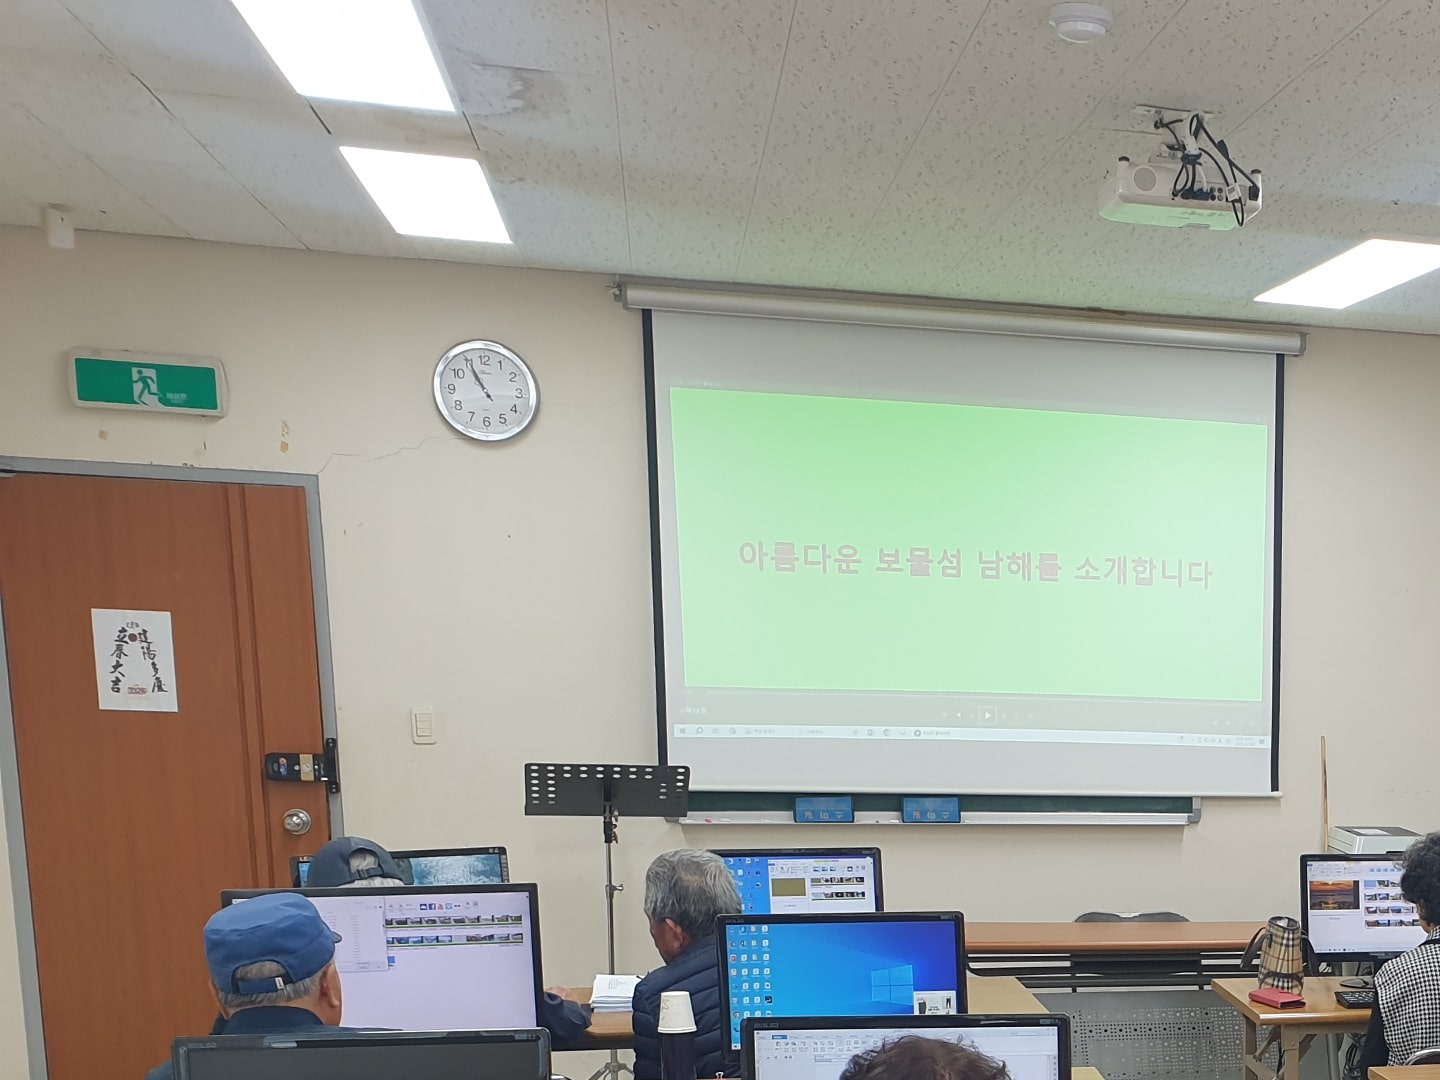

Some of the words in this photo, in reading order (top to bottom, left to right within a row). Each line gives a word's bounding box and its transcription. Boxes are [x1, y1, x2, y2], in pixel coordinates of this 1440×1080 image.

[479, 355, 491, 366] 12
[452, 368, 465, 380] 10
[509, 372, 517, 383] 2
[448, 384, 456, 395] 9
[515, 388, 523, 399] 3
[454, 400, 463, 411] 8
[510, 404, 518, 415] 4
[468, 411, 476, 422] 7
[499, 414, 507, 425] 5
[483, 417, 491, 428] 6
[739, 540, 862, 575] 아름다운
[875, 547, 962, 579] 보물섬
[978, 549, 1062, 582] 남해를
[1074, 554, 1214, 590] 소개합니다
